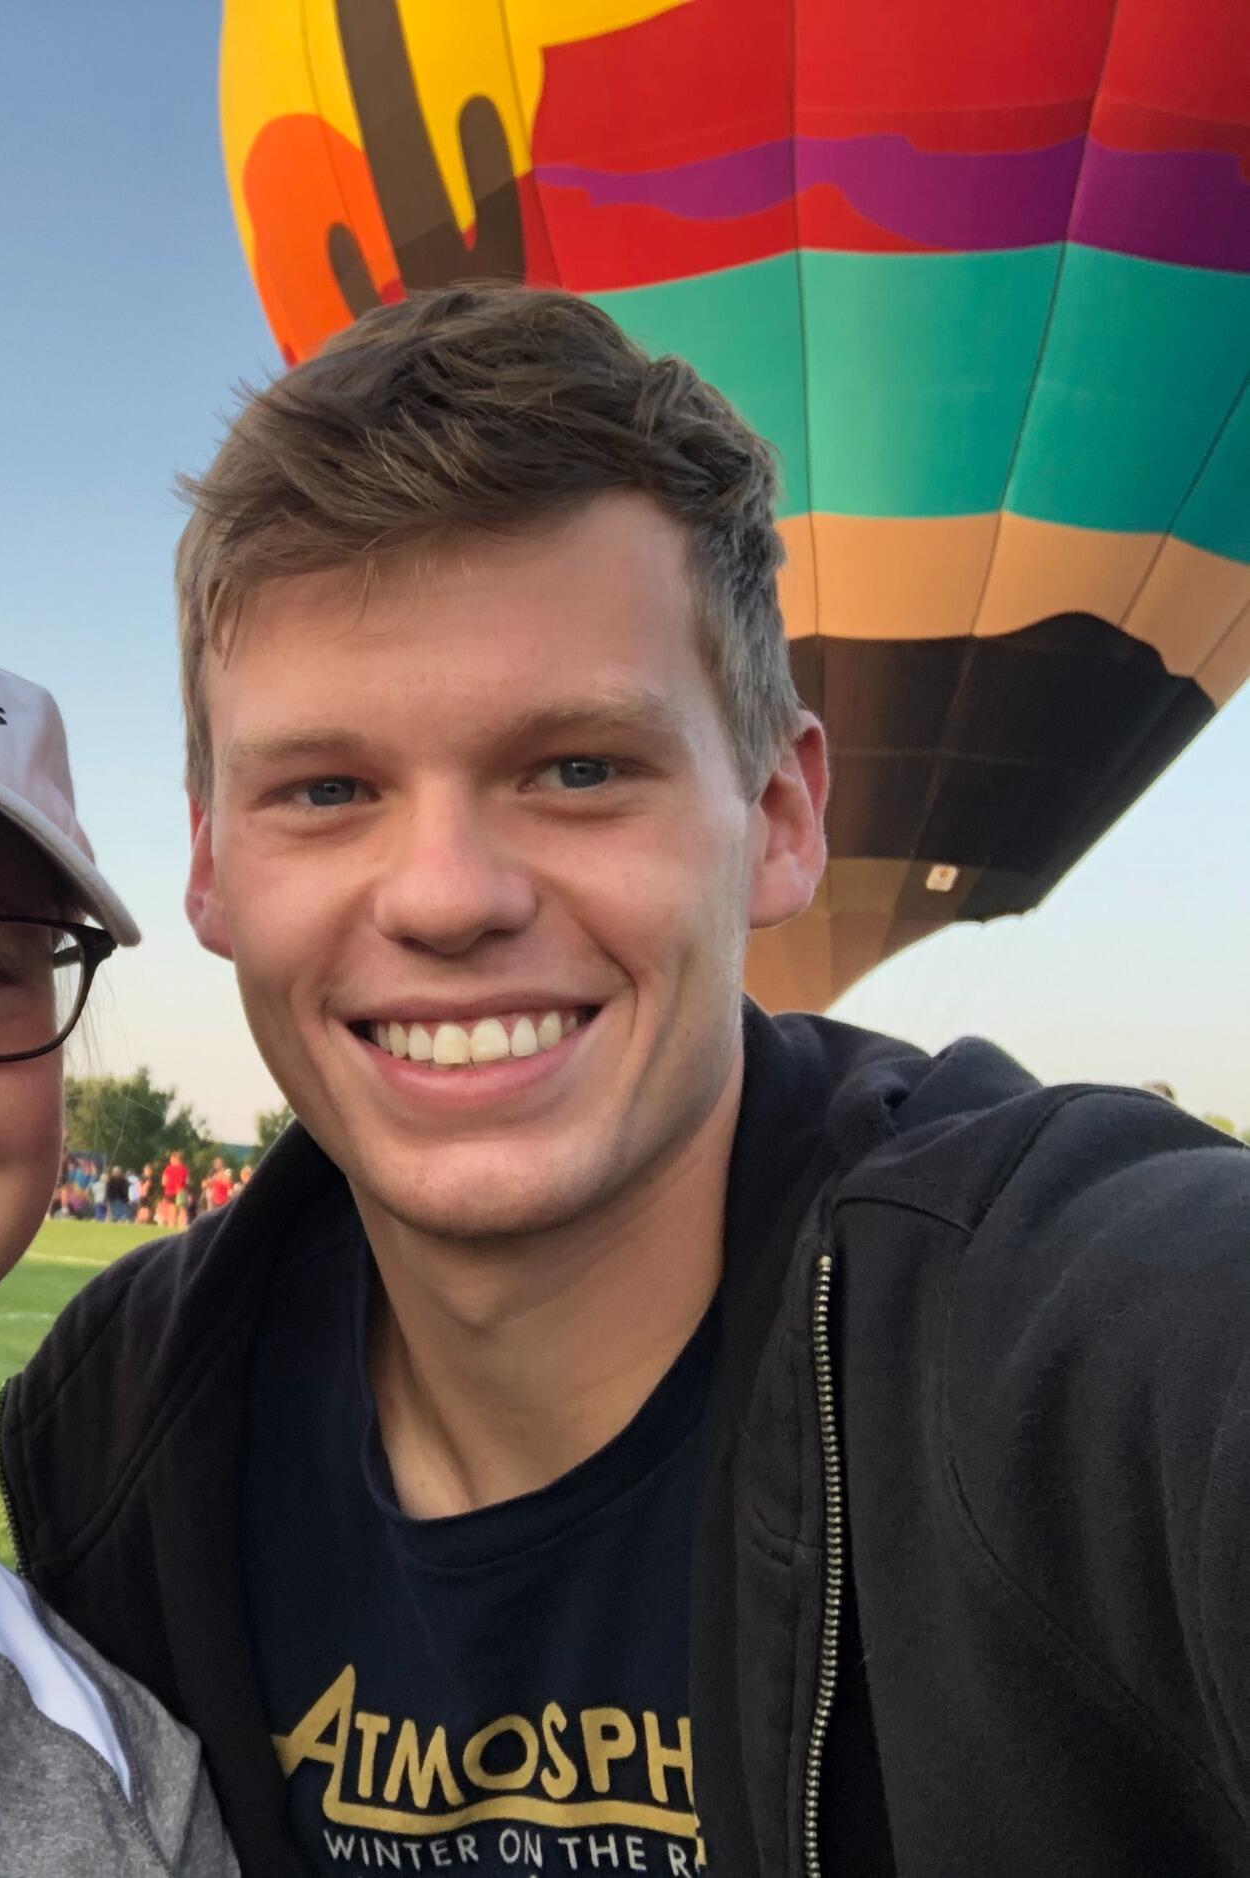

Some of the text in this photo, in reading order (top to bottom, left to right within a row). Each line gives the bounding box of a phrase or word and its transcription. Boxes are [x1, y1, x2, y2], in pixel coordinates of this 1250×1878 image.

[323, 1828, 701, 1877] WINTER ON THE R
